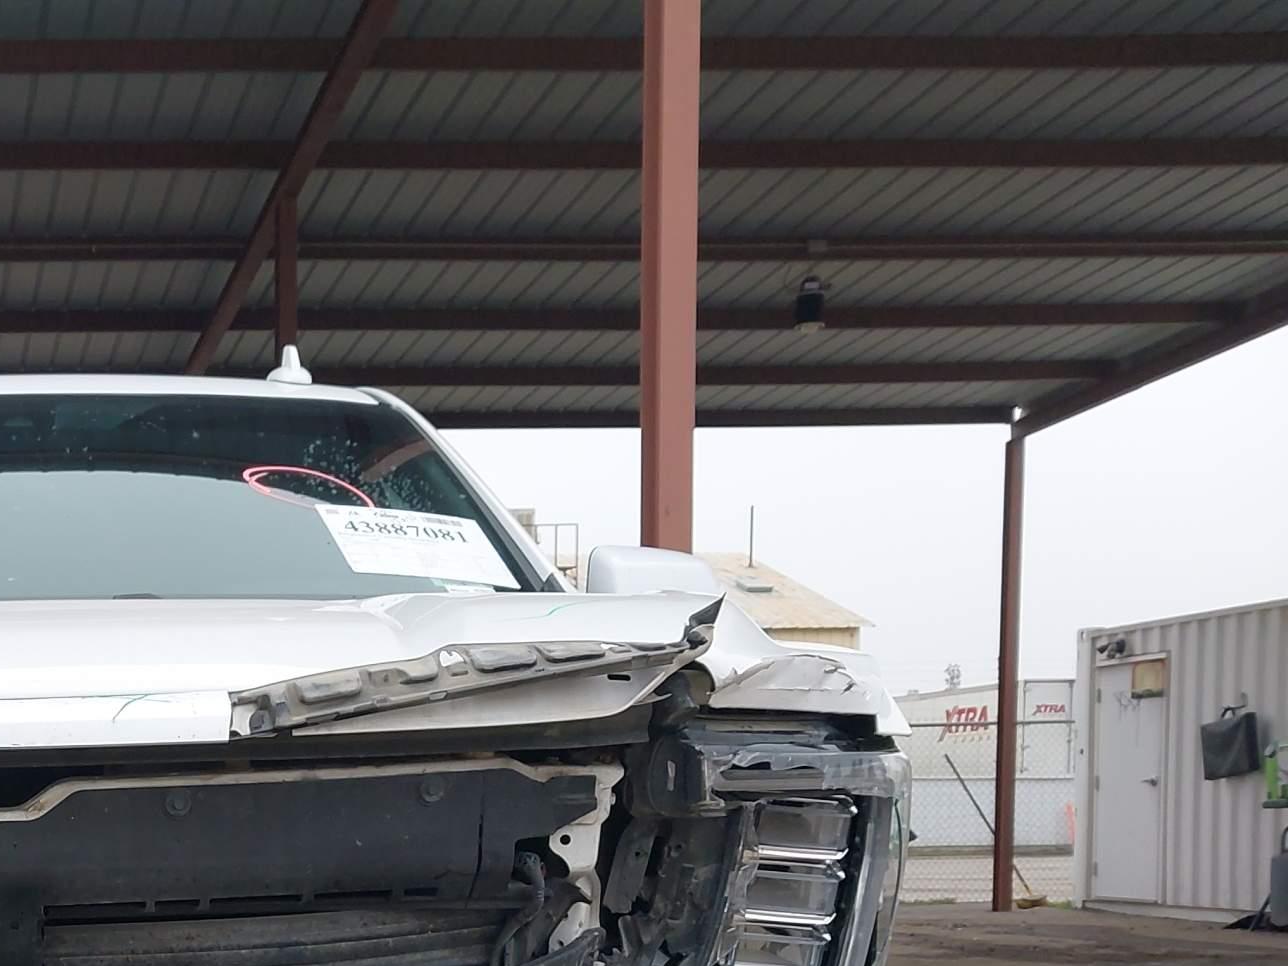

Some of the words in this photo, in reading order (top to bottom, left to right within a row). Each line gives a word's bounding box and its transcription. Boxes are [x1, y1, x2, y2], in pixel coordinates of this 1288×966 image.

[344, 520, 468, 544] 43887081
[1031, 704, 1066, 716] XTRA
[937, 705, 989, 742] XTRA
